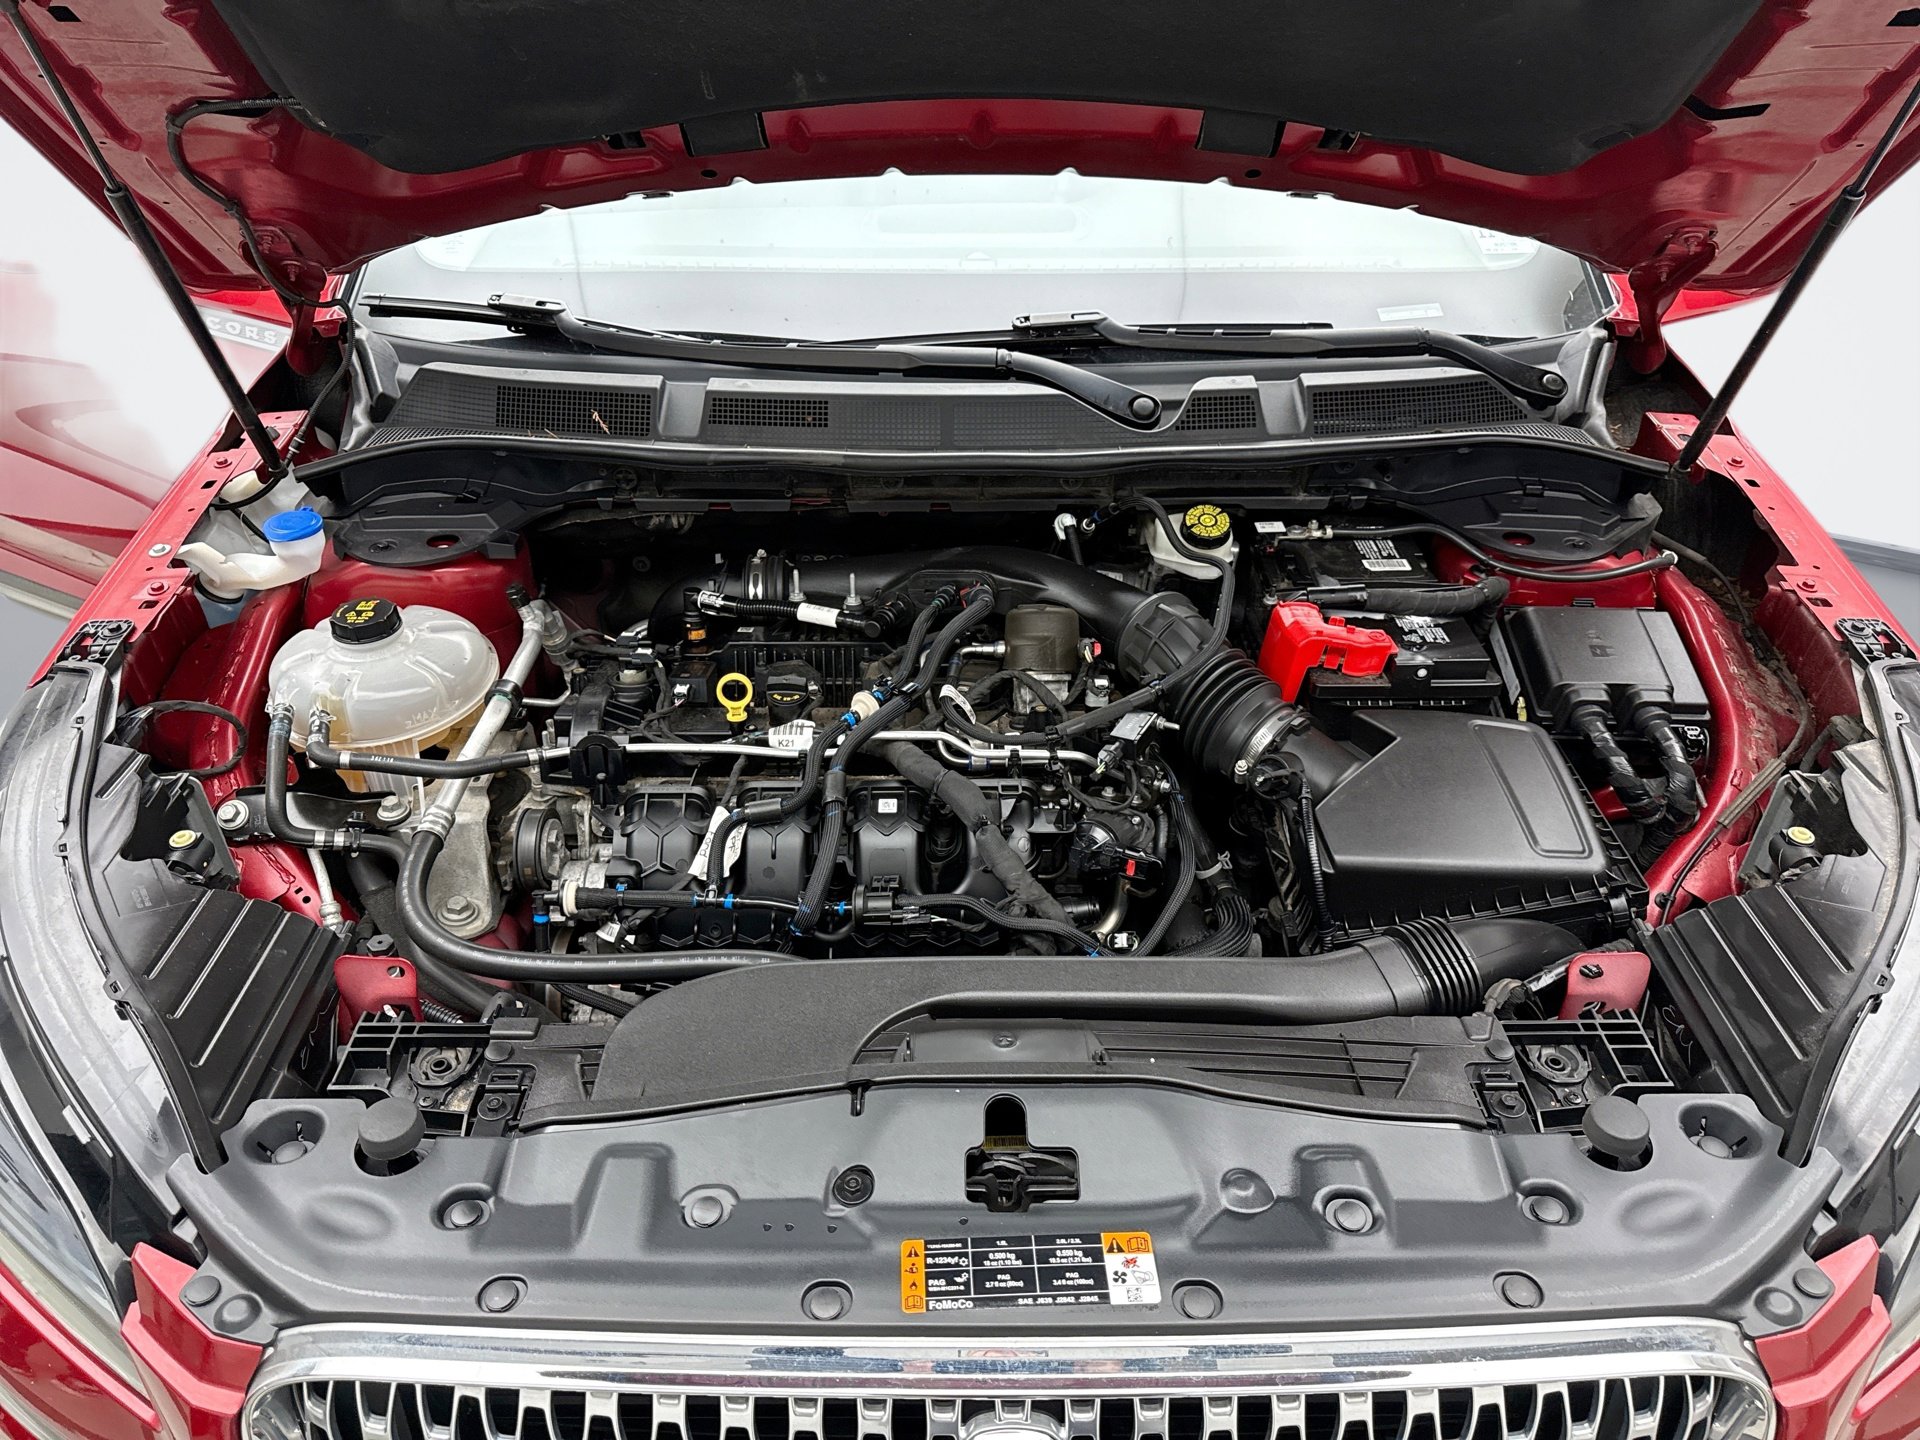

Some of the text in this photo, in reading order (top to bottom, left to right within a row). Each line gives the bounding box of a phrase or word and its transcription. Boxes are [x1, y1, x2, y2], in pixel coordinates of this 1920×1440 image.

[778, 739, 795, 748] K21
[989, 1252, 1016, 1260] 0.500 kg
[1056, 1249, 1083, 1257] 0.550 kg
[926, 1256, 959, 1265] R-1234yf
[928, 1299, 974, 1310] FoMoCo
[1018, 1297, 1034, 1305] SAE
